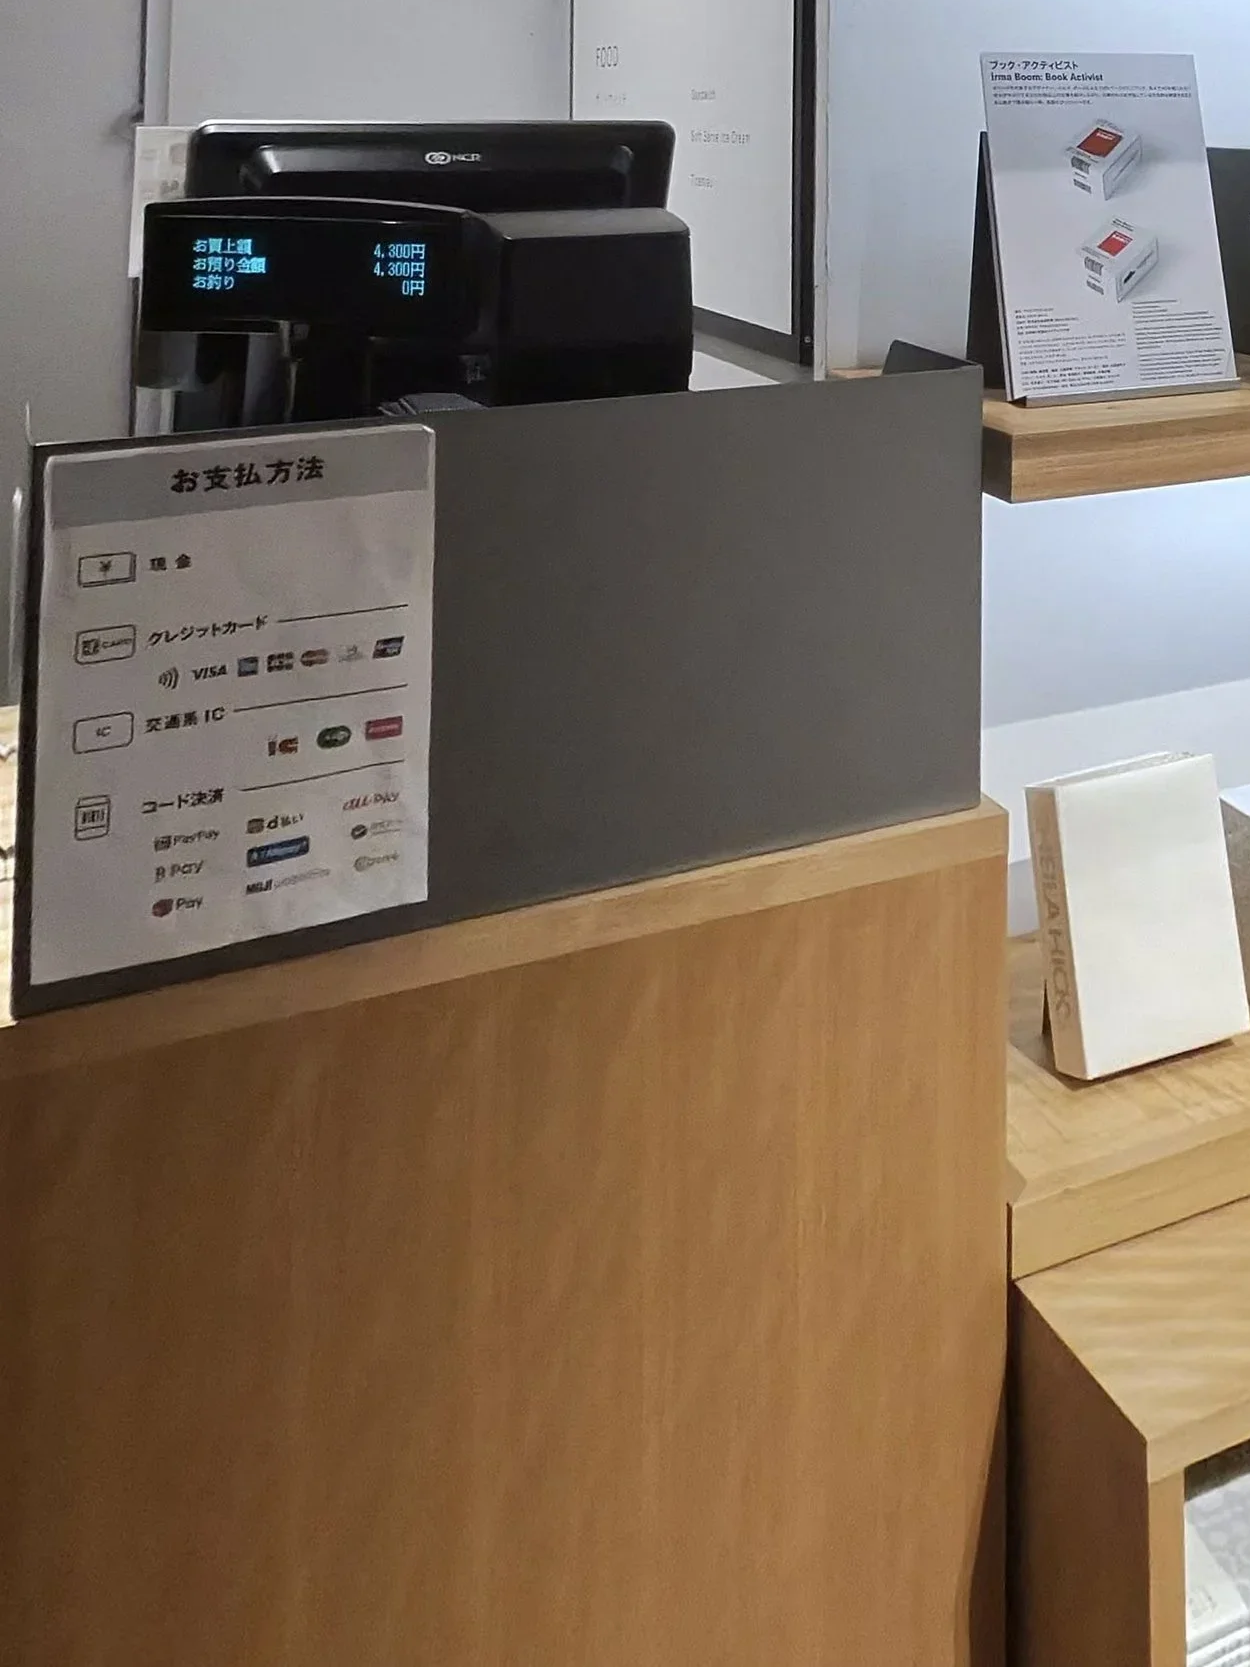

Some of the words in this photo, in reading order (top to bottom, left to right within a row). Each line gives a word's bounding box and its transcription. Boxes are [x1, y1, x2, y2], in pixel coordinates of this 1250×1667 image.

[989, 60, 1079, 71] ブック・アクティビスト
[990, 72, 1012, 81] Irma
[1045, 72, 1067, 81] Book
[1070, 73, 1104, 82] Activist
[193, 238, 253, 256] お買上額
[193, 257, 267, 274] お預り金額
[193, 275, 236, 291] お釣り
[402, 280, 425, 297] 0円
[170, 455, 325, 494] お支払方法
[149, 552, 192, 572] 現金
[148, 614, 268, 646] クレジットカード
[190, 663, 228, 682] VISA
[204, 706, 226, 724] IC
[141, 787, 225, 815] コード決済
